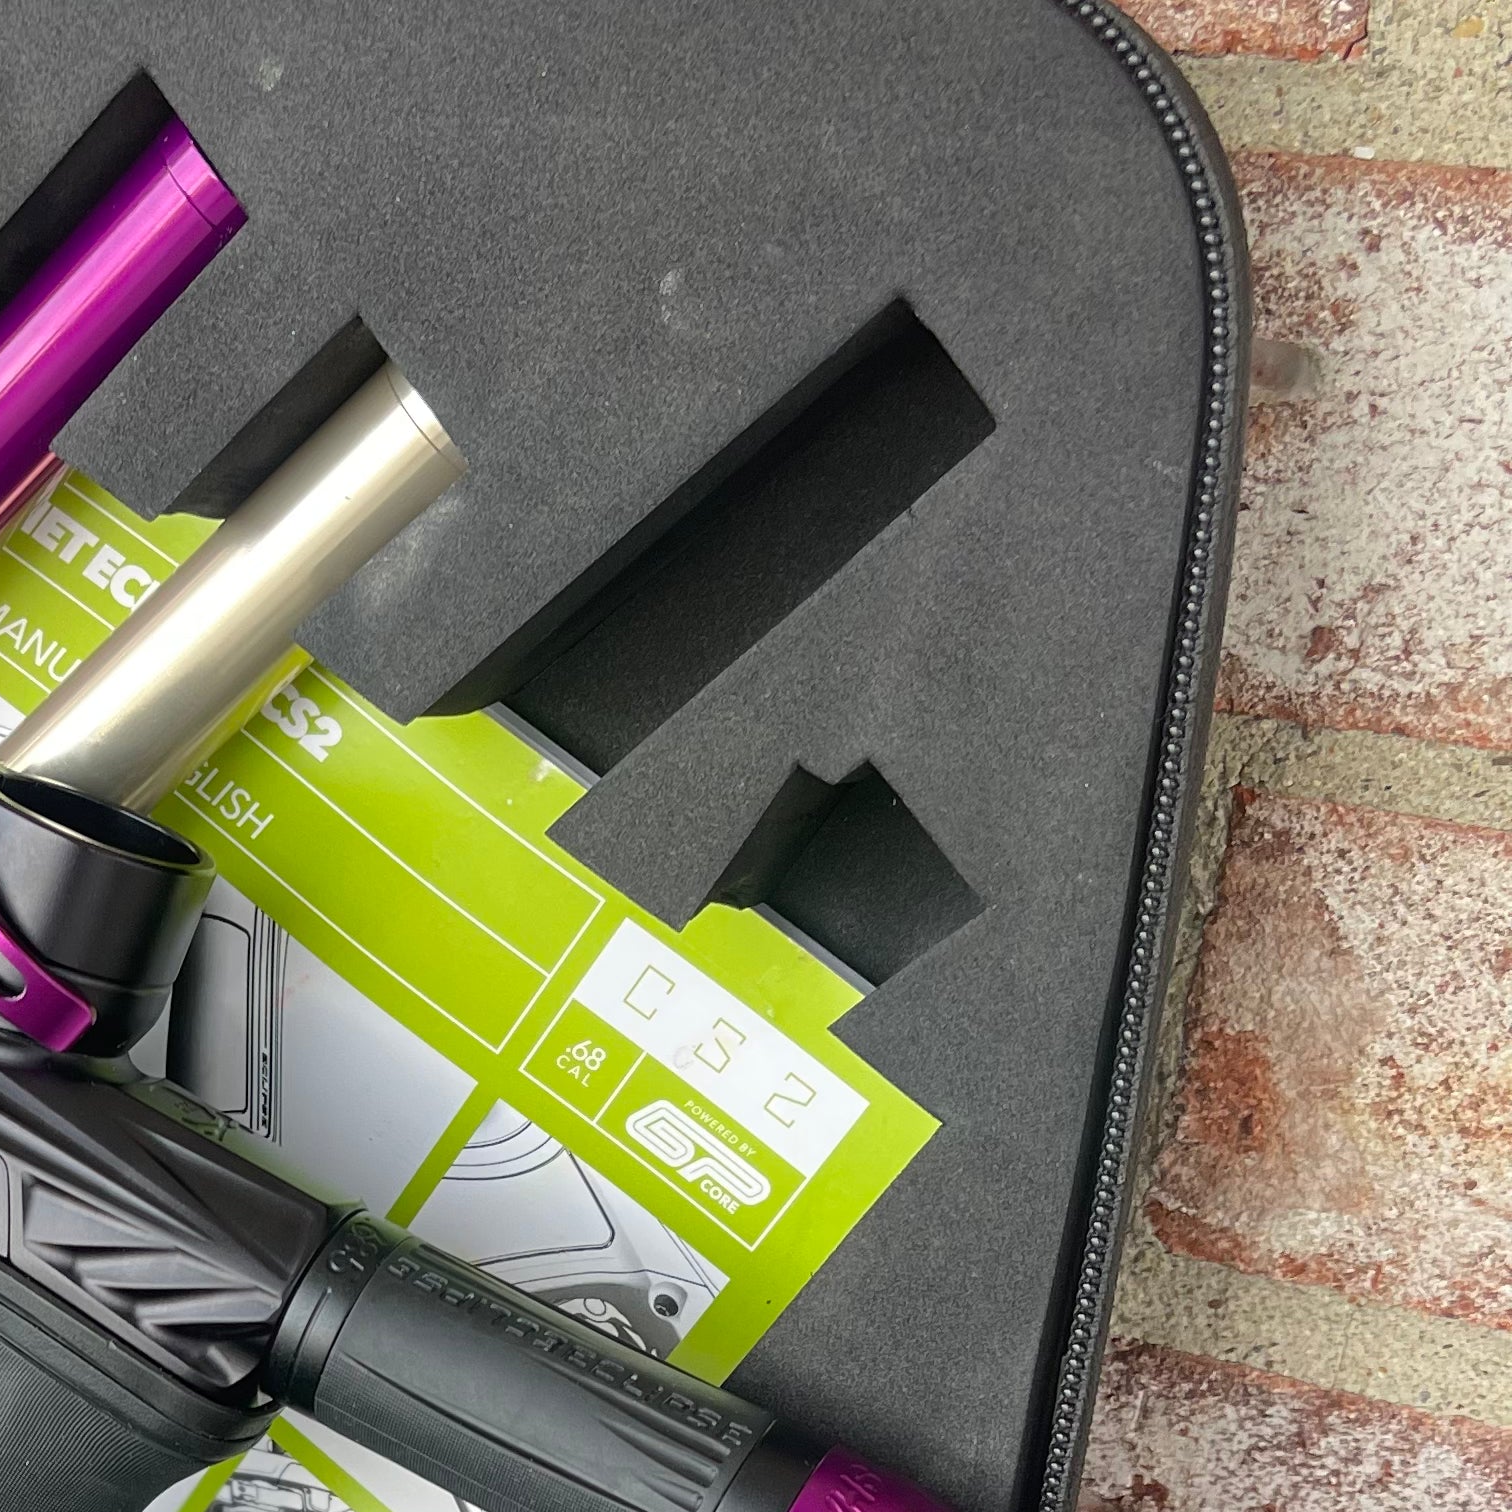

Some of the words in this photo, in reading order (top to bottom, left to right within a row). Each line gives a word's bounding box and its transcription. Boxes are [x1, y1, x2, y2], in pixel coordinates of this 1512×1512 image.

[260, 683, 343, 763] CS2
[556, 1054, 590, 1088] CAL
[565, 1039, 607, 1071] .68
[684, 1100, 738, 1145] POWERED
[739, 1140, 757, 1158] BY
[699, 1178, 741, 1215] CORE
